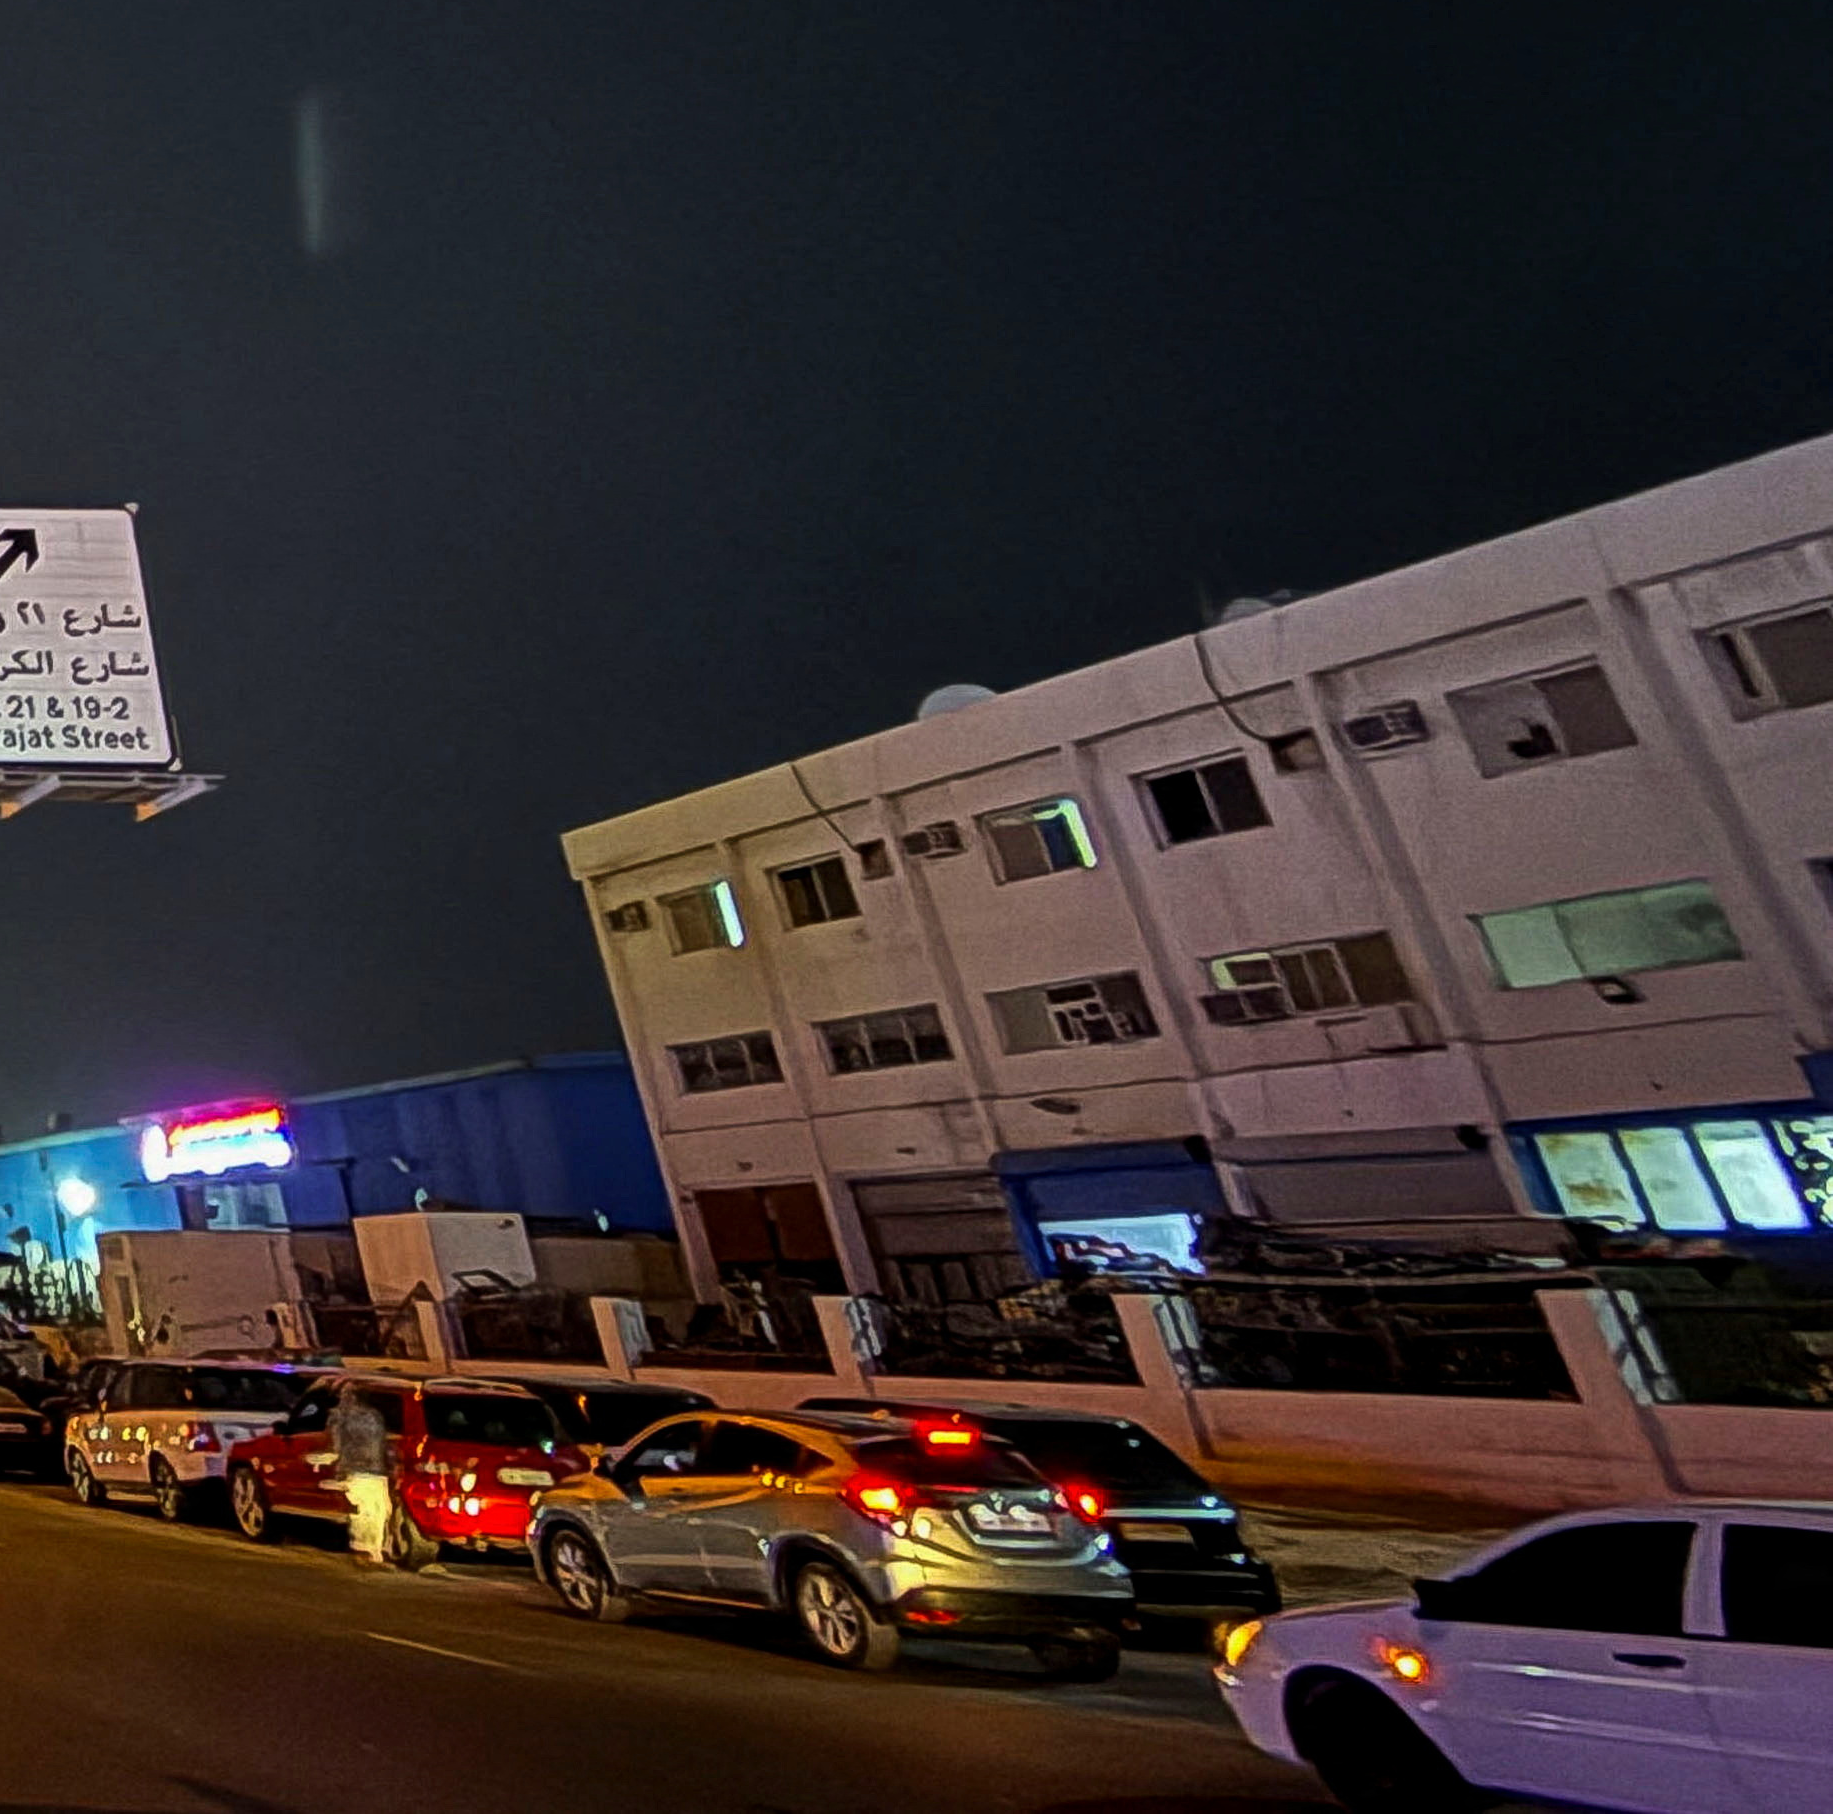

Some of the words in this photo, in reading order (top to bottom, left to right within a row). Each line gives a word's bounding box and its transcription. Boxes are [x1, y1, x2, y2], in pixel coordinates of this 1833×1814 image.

[63, 603, 141, 636] شارع
[71, 651, 149, 685] شارع
[7, 695, 35, 719] 21
[47, 696, 64, 718] &
[72, 696, 130, 720] 19-2
[62, 724, 150, 751] Street
